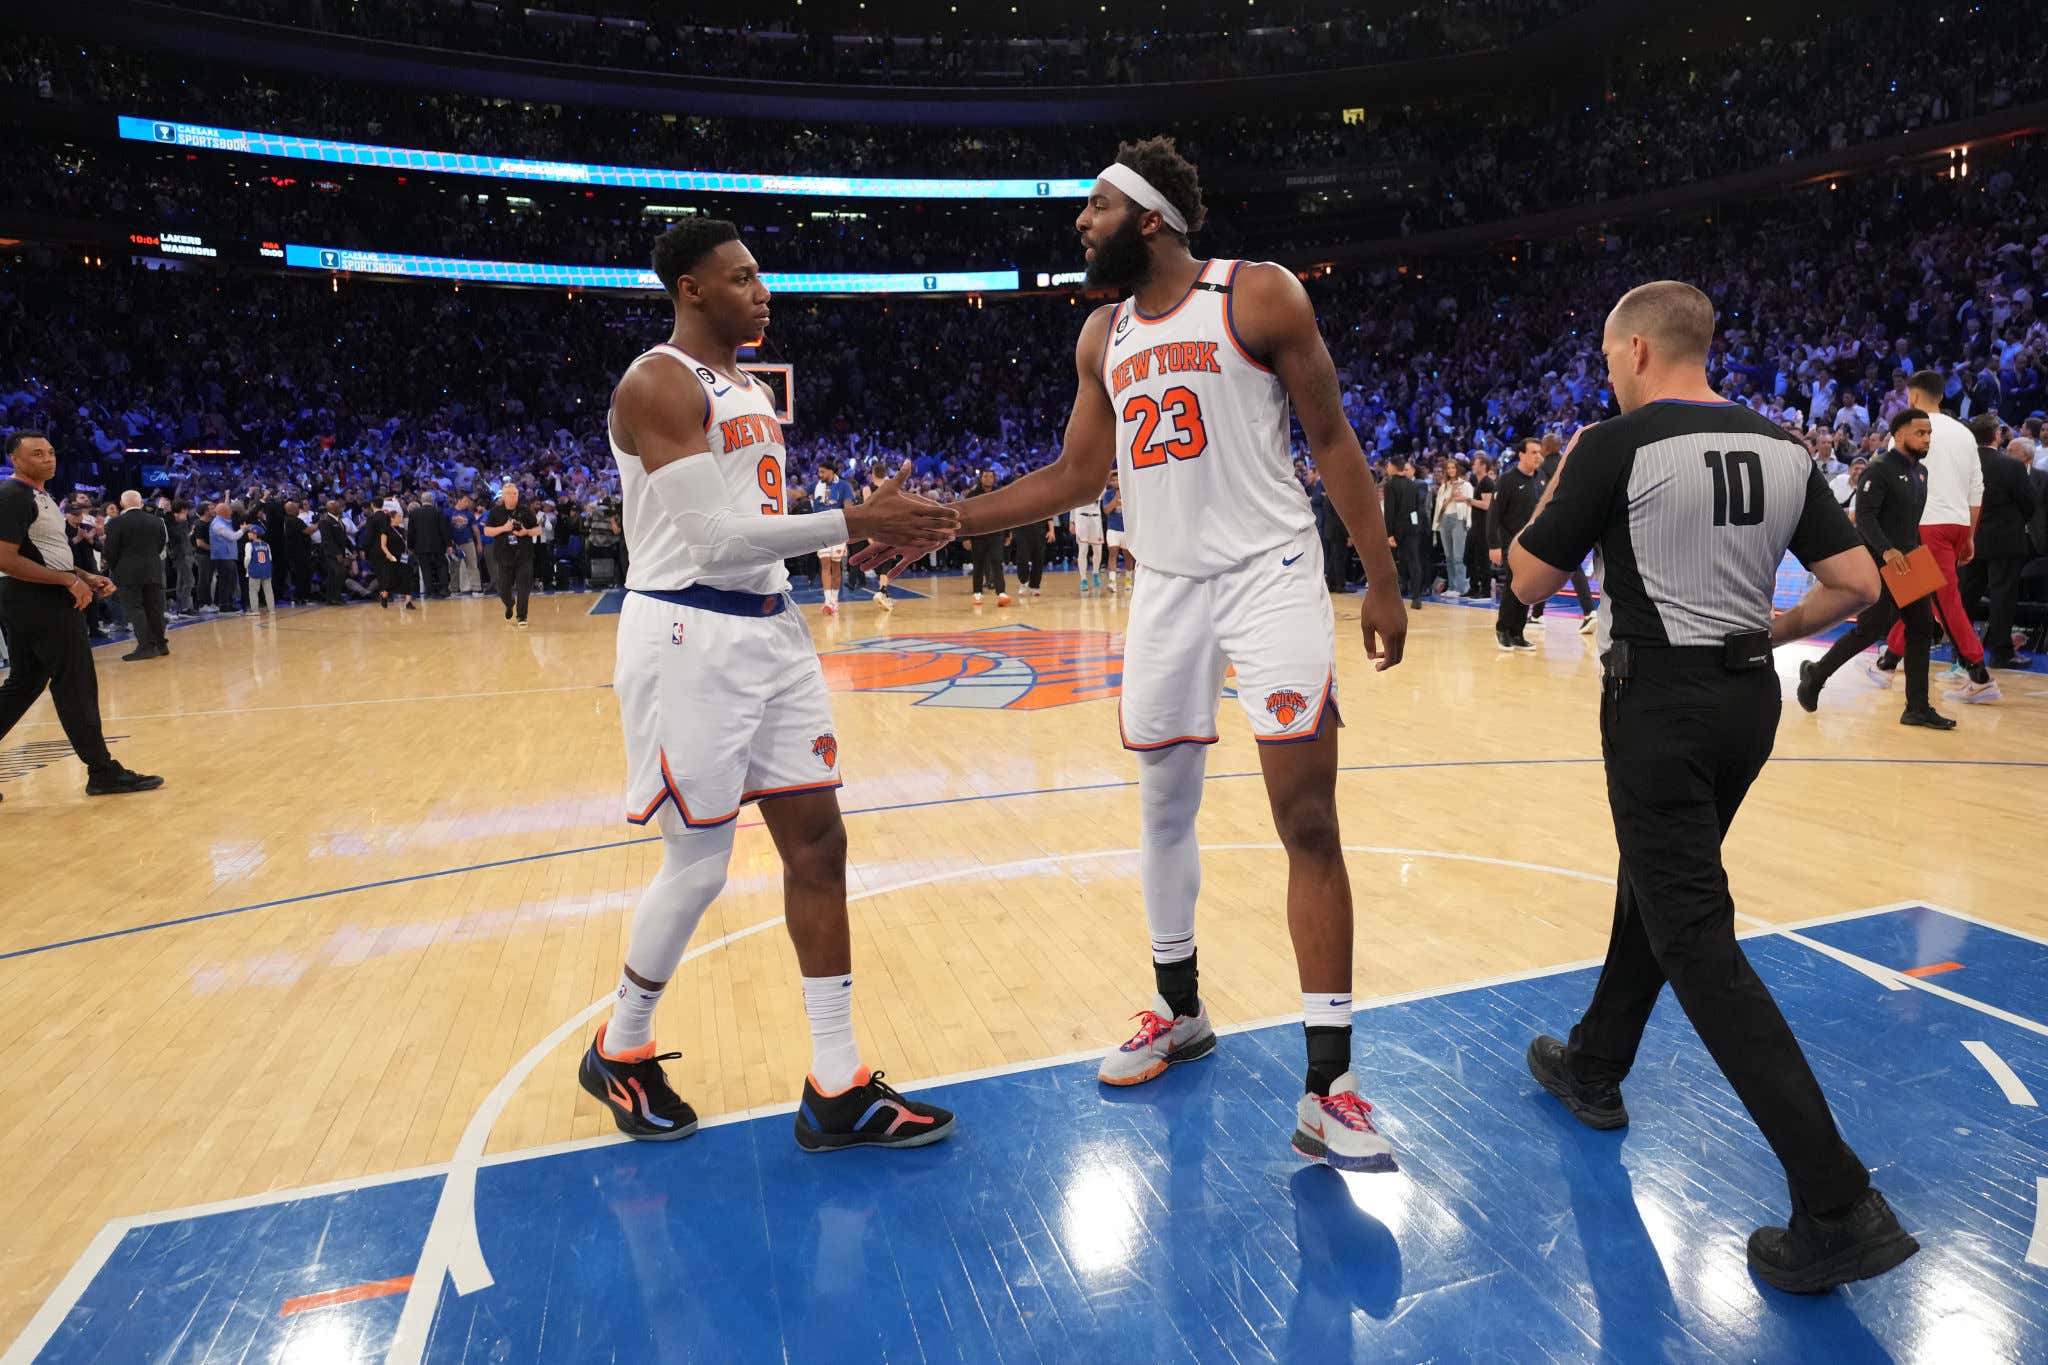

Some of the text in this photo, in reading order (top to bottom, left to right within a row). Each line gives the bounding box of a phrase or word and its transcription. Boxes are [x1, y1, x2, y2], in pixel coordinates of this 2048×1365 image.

[177, 125, 220, 137] CAESARS
[177, 133, 248, 152] SPORTSBOOK
[129, 234, 160, 246] 10:04
[160, 232, 202, 246] LAKERS
[262, 241, 280, 250] NBA
[160, 243, 217, 257] WARRIORS
[259, 248, 284, 258] 10:00
[341, 260, 405, 275] SPORTSBOOK
[1111, 341, 1221, 400] NEW YORK
[720, 413, 766, 454] NEW
[1123, 385, 1208, 470] 23
[757, 454, 784, 515] 9
[1703, 450, 1765, 527] 10
